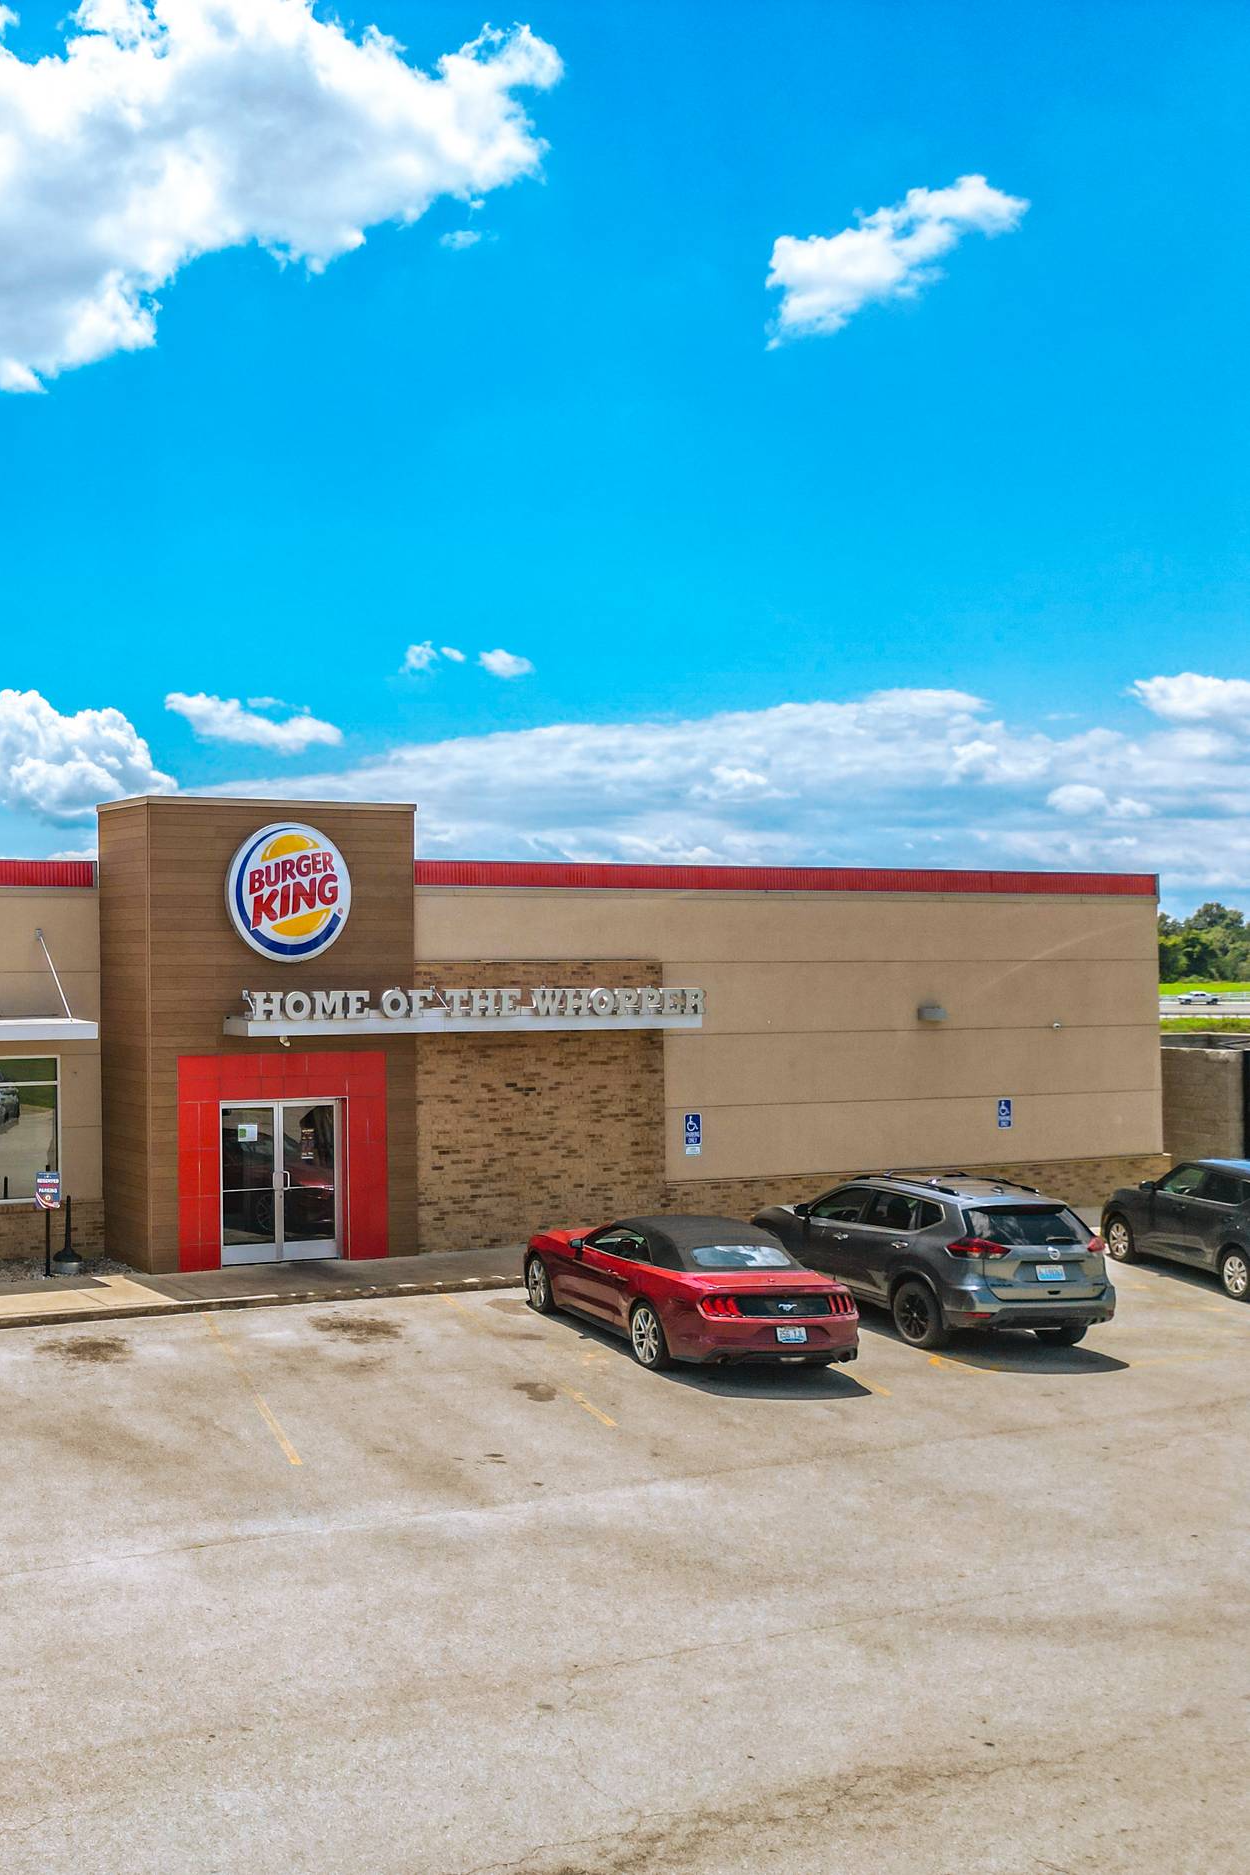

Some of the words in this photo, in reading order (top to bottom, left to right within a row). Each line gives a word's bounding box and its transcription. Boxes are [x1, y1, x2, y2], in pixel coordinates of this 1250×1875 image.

[249, 852, 334, 895] BURGER
[252, 874, 339, 928] KING
[251, 990, 370, 1020] HOME
[381, 988, 434, 1018] OF
[444, 988, 521, 1017] THE
[531, 987, 706, 1016] WHOPPER
